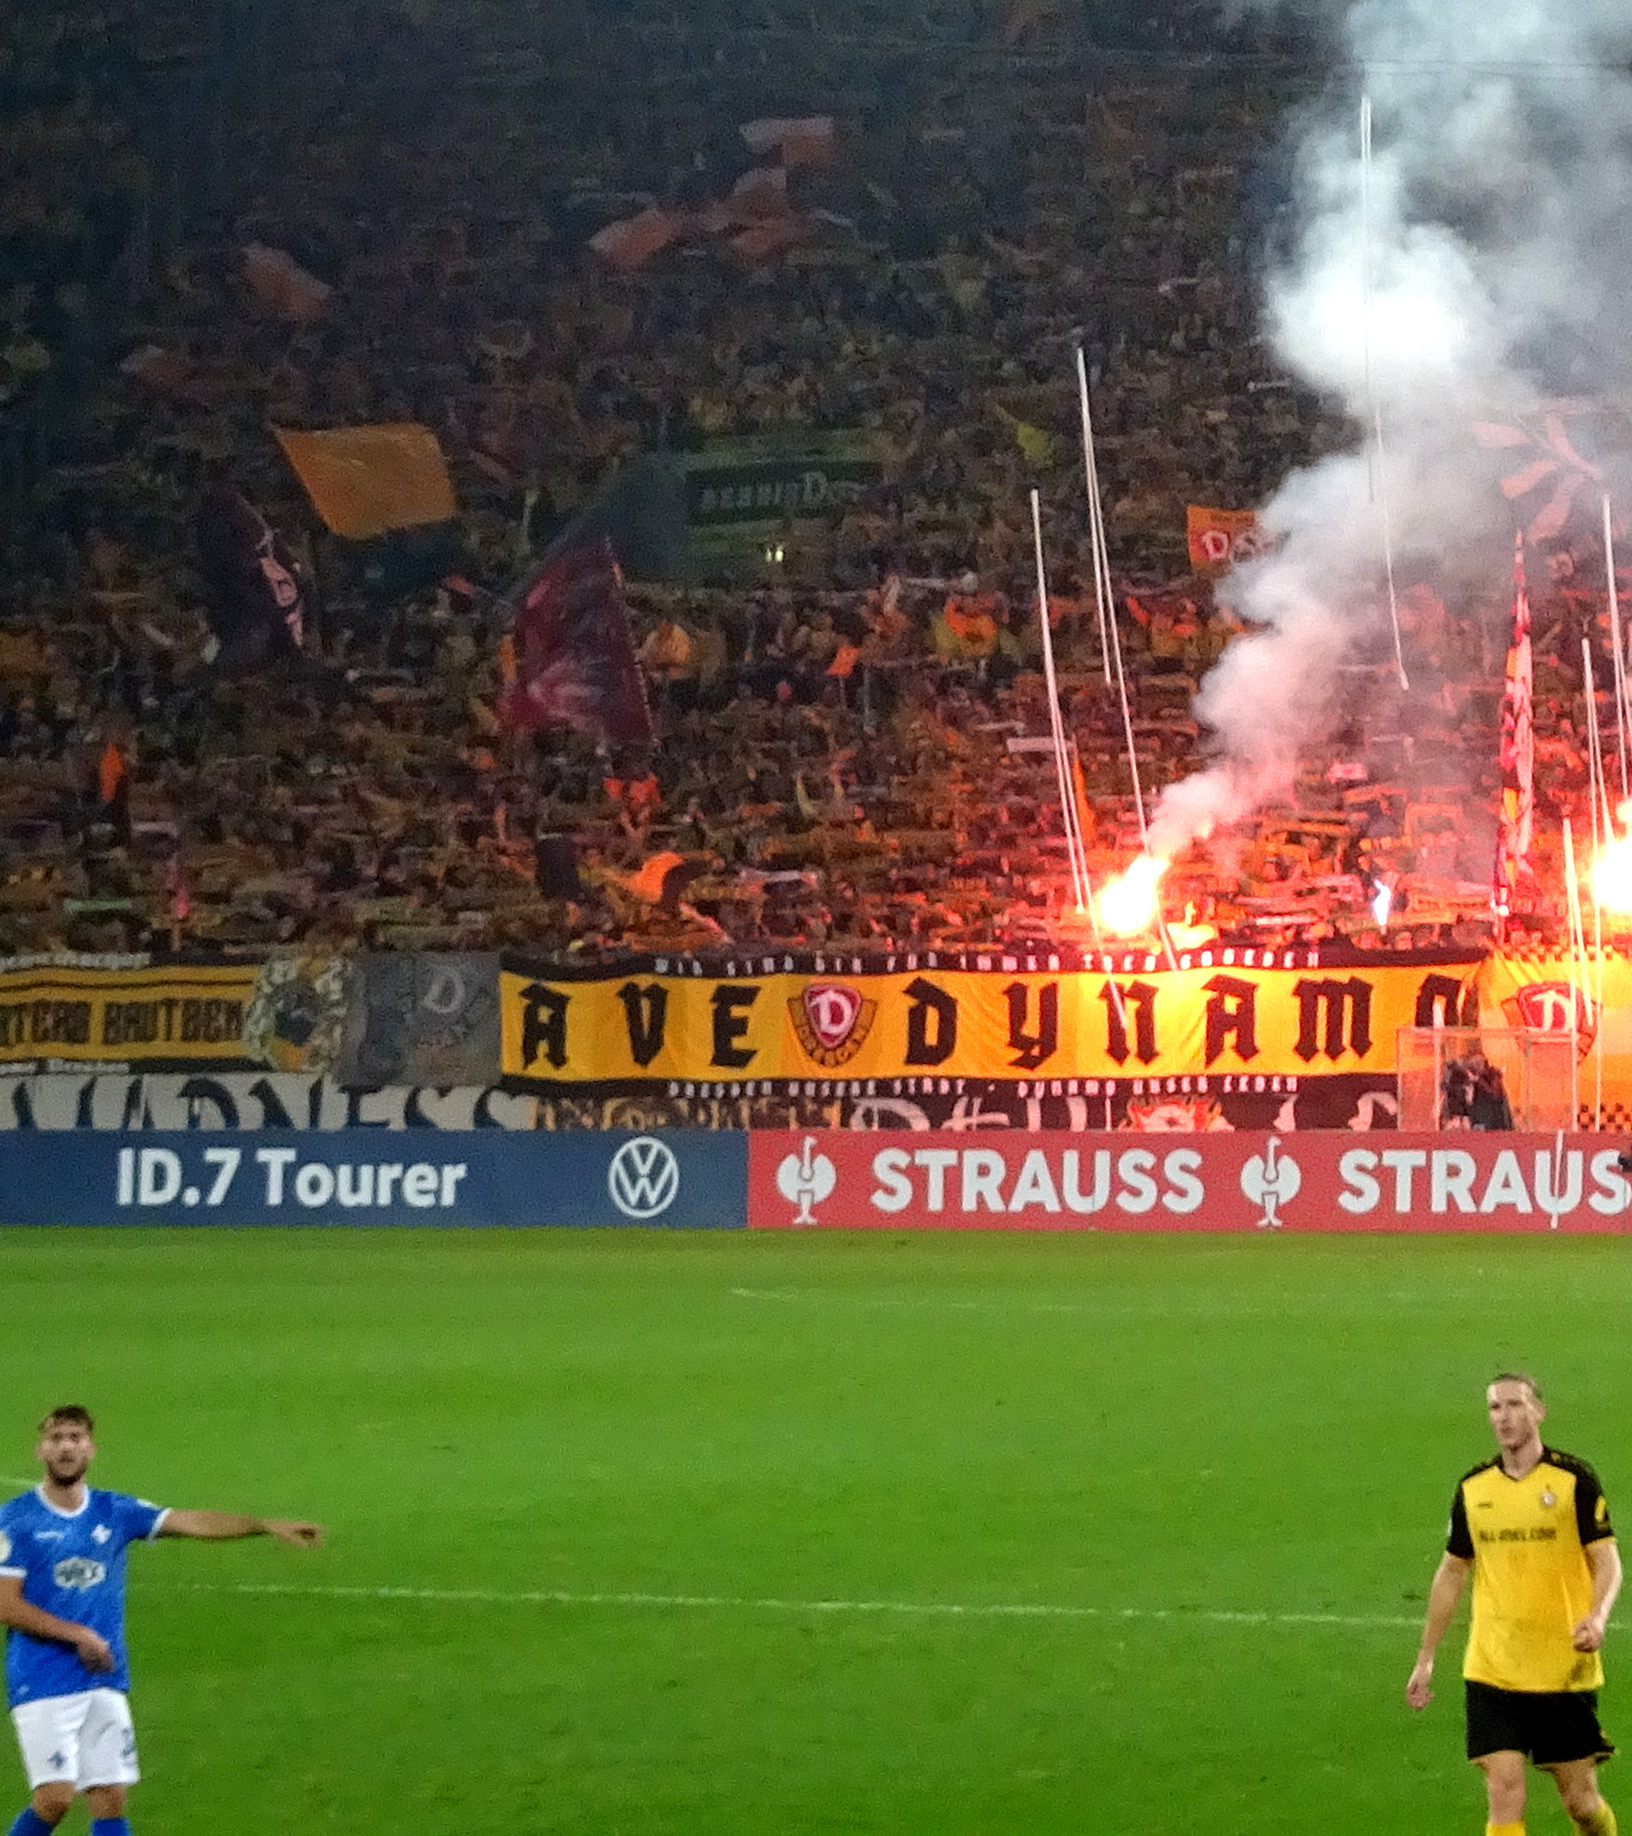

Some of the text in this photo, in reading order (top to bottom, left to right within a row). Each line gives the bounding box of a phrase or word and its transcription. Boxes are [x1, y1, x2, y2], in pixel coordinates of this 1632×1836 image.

[519, 981, 761, 1071] AVE
[117, 1147, 468, 1208] ID.7 Tourer
[869, 1147, 1205, 1215] STRAUSS
